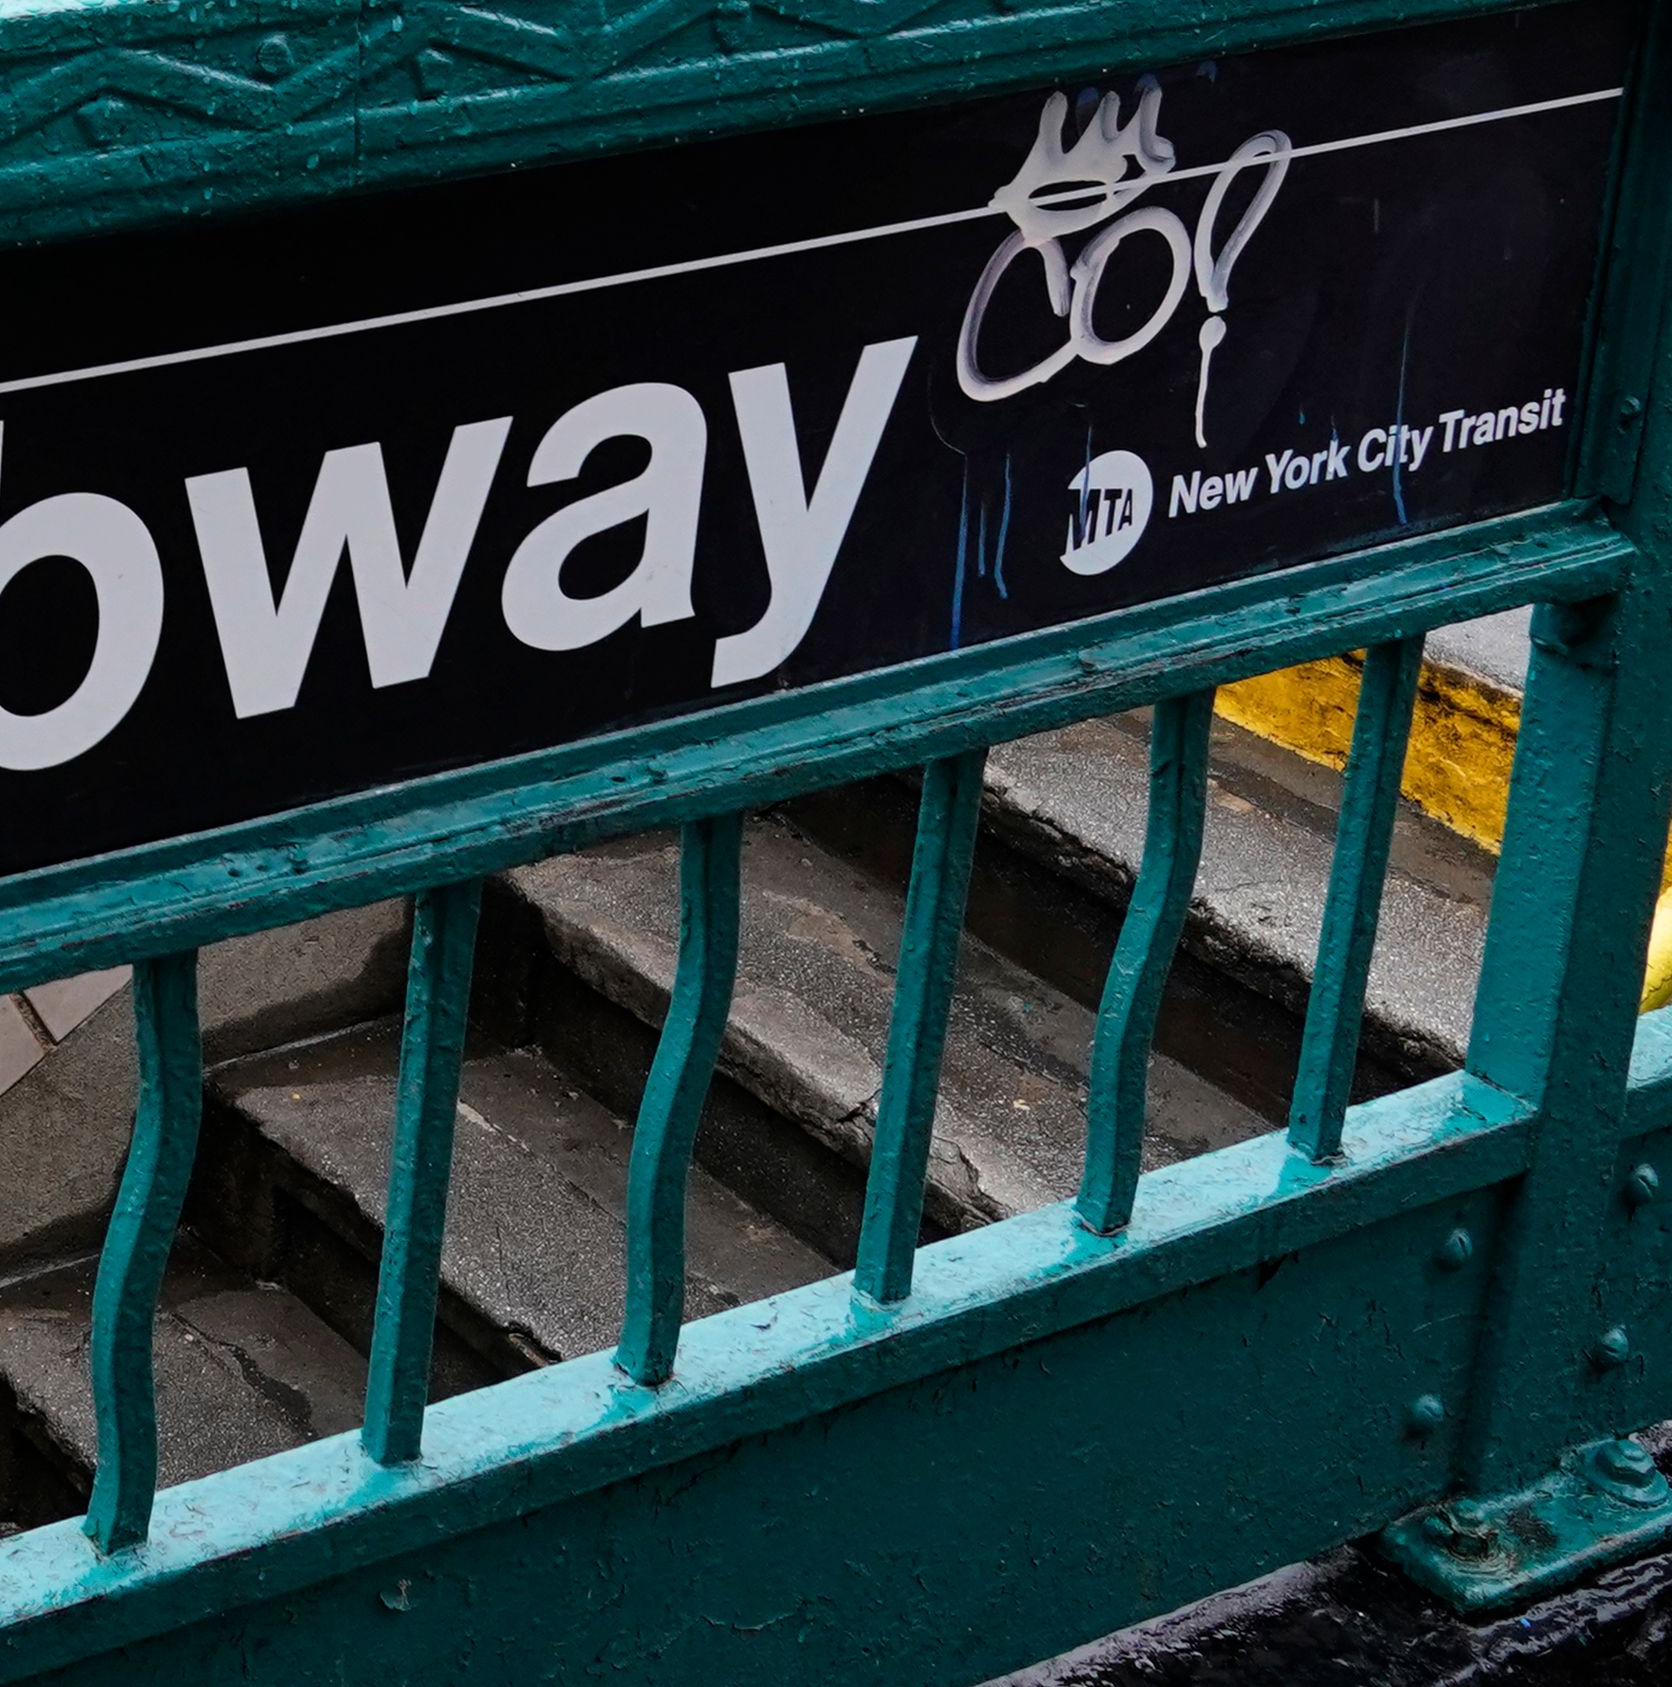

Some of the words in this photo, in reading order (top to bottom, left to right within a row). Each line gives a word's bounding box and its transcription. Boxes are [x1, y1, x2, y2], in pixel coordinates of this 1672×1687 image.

[1064, 487, 1134, 555] MTA
[1168, 465, 1259, 519] New
[1264, 439, 1352, 494] York
[1357, 425, 1434, 473] City
[1437, 387, 1567, 454] Transit
